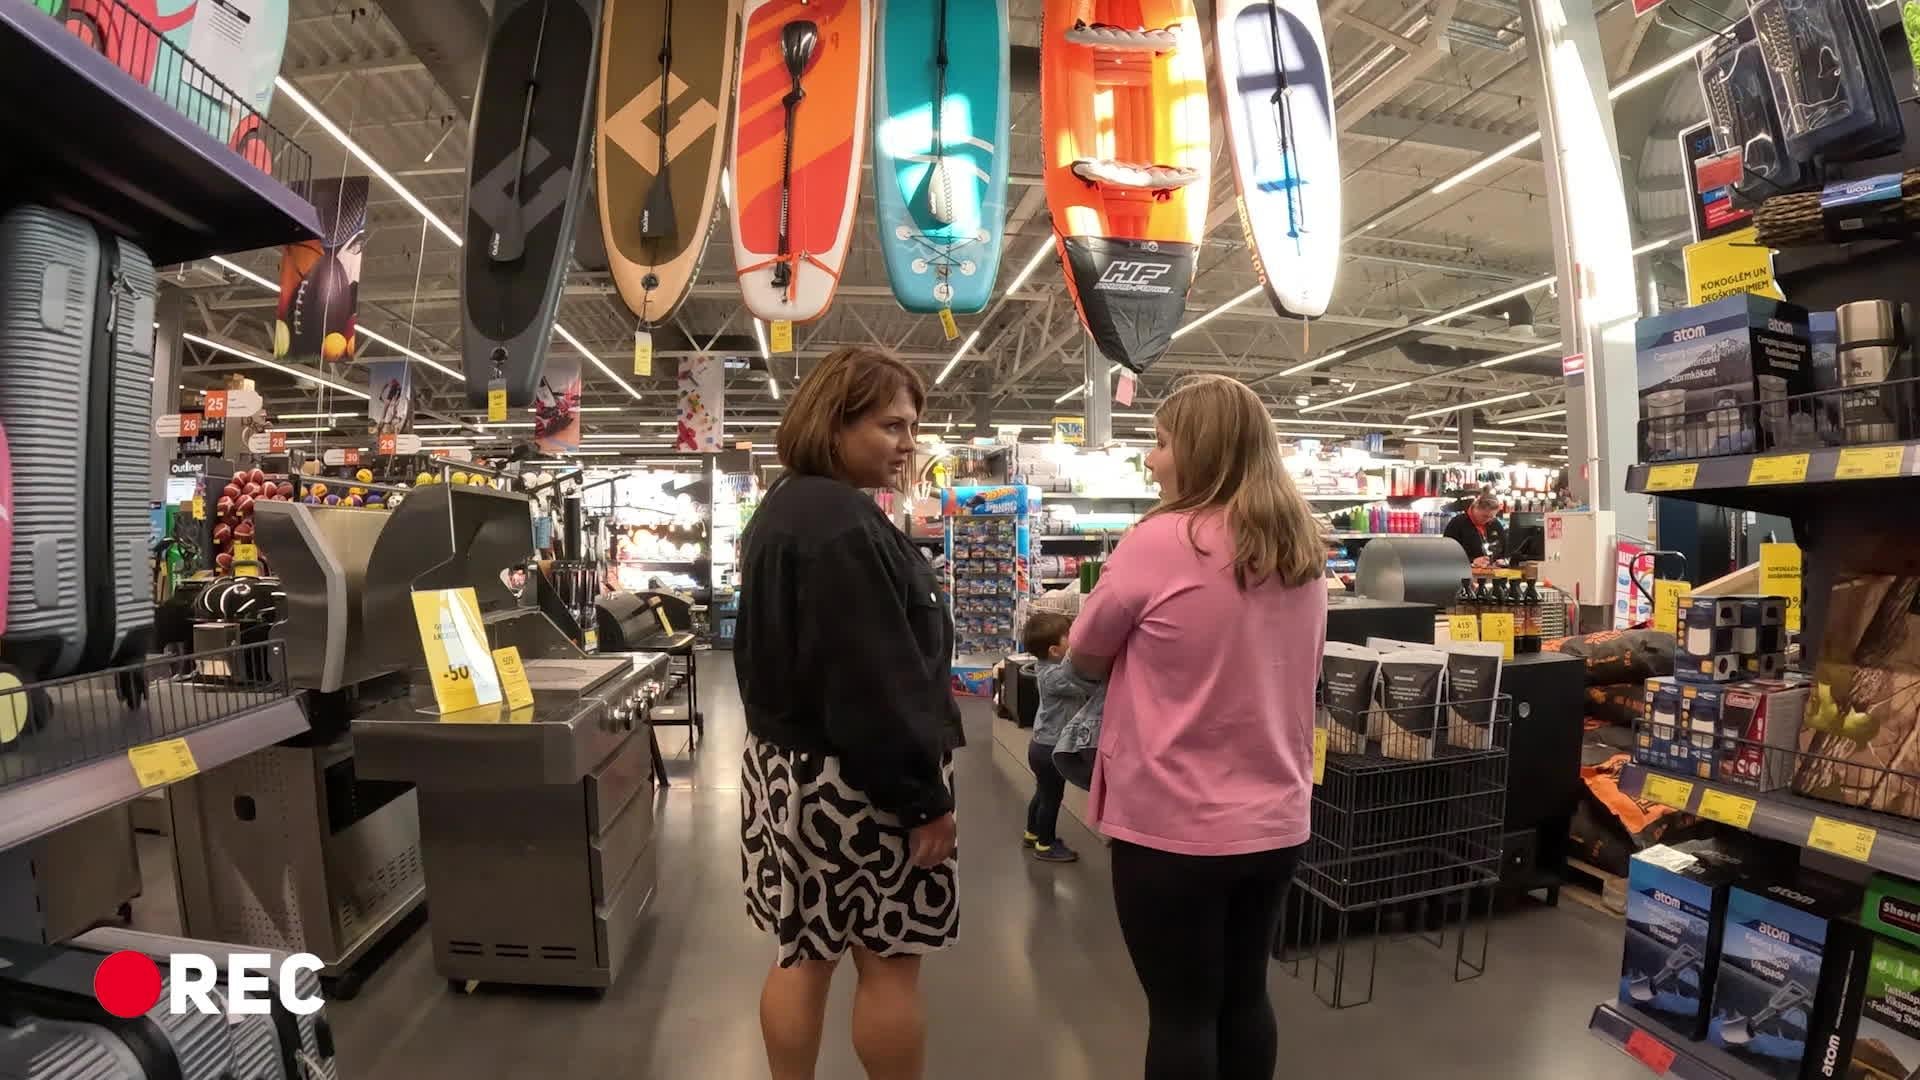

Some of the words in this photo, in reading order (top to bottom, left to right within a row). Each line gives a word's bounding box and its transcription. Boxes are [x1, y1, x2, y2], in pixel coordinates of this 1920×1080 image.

[1099, 261, 1172, 285] HF
[1753, 267, 1767, 278] UN
[1673, 324, 1706, 343] atom
[1767, 317, 1794, 335] atom
[207, 397, 224, 411] 25
[183, 419, 197, 431] 26
[272, 438, 284, 448] 28
[381, 439, 394, 449] 29
[346, 453, 358, 462] 30
[1654, 890, 1681, 909] atom
[1767, 885, 1816, 905] atom
[1758, 922, 1791, 944] atom
[1822, 1033, 1841, 1077] atom
